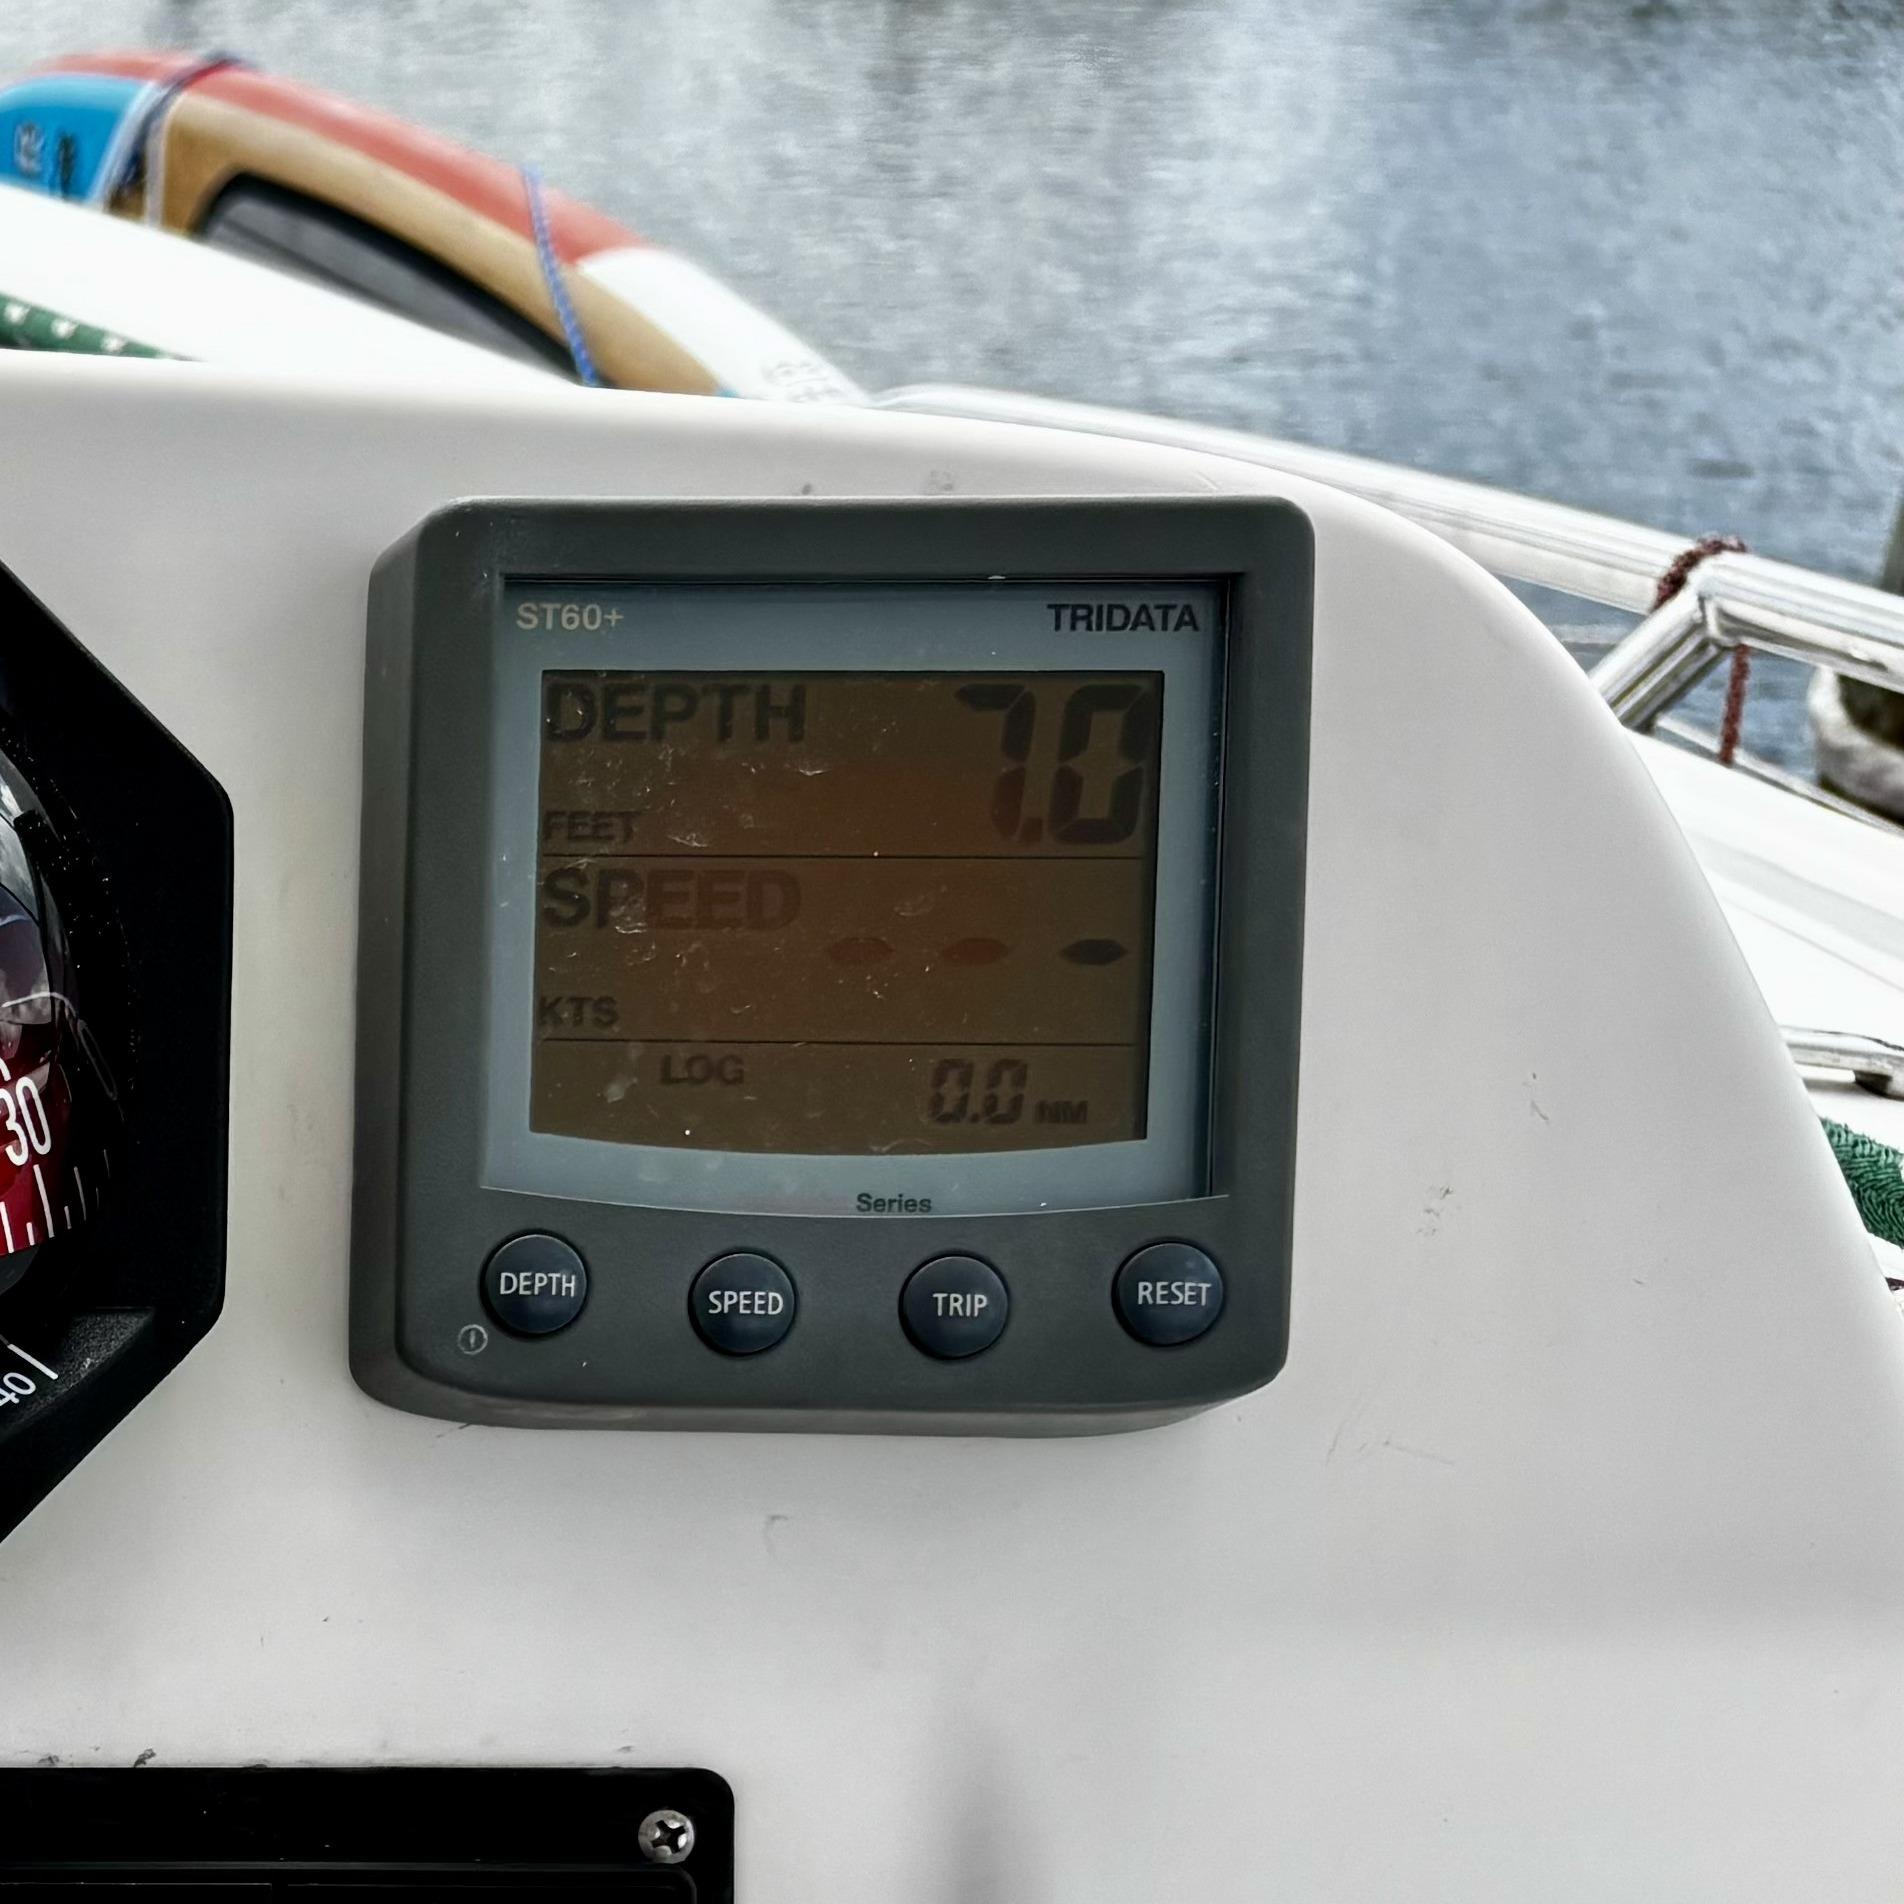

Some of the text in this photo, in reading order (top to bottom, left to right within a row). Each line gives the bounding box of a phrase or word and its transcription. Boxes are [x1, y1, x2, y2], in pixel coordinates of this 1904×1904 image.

[515, 603, 624, 632] ST60+
[1047, 602, 1200, 633] TRIDATA
[542, 684, 807, 745] DEPTH
[954, 684, 1151, 847] 7.0
[542, 810, 639, 843] FEET
[540, 868, 801, 932] SPEED
[537, 996, 619, 1027] KTS
[659, 1054, 745, 1087] LOG
[930, 1058, 1029, 1125] 0.0
[855, 1191, 932, 1216] Series
[499, 1270, 577, 1299] DEPTH
[1136, 1279, 1212, 1307] RESET
[707, 1289, 784, 1317] SPEED
[932, 1291, 988, 1319] TRIP
